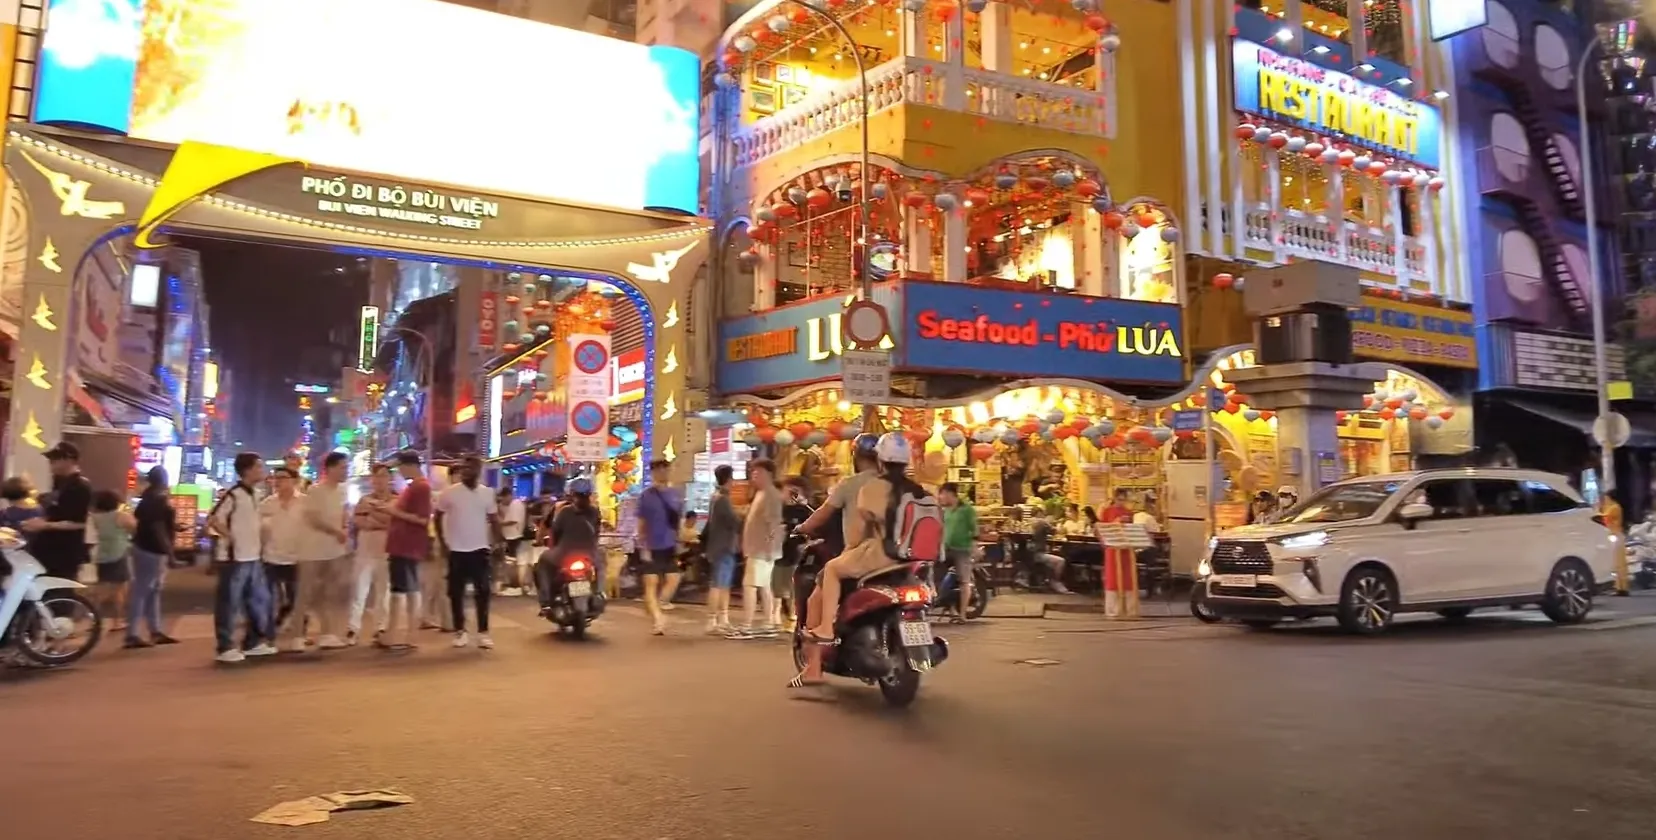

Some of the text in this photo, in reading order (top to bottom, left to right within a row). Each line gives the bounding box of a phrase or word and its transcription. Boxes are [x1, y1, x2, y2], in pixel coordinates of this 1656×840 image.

[1258, 67, 1418, 155] RESTAURANT
[302, 176, 499, 218] PHỐ ĐI BỘ BÙI VIỆN
[318, 200, 483, 229] BUI VIEN WALKING STREET
[917, 309, 1038, 347] Seafood
[1115, 321, 1182, 358] LÚA
